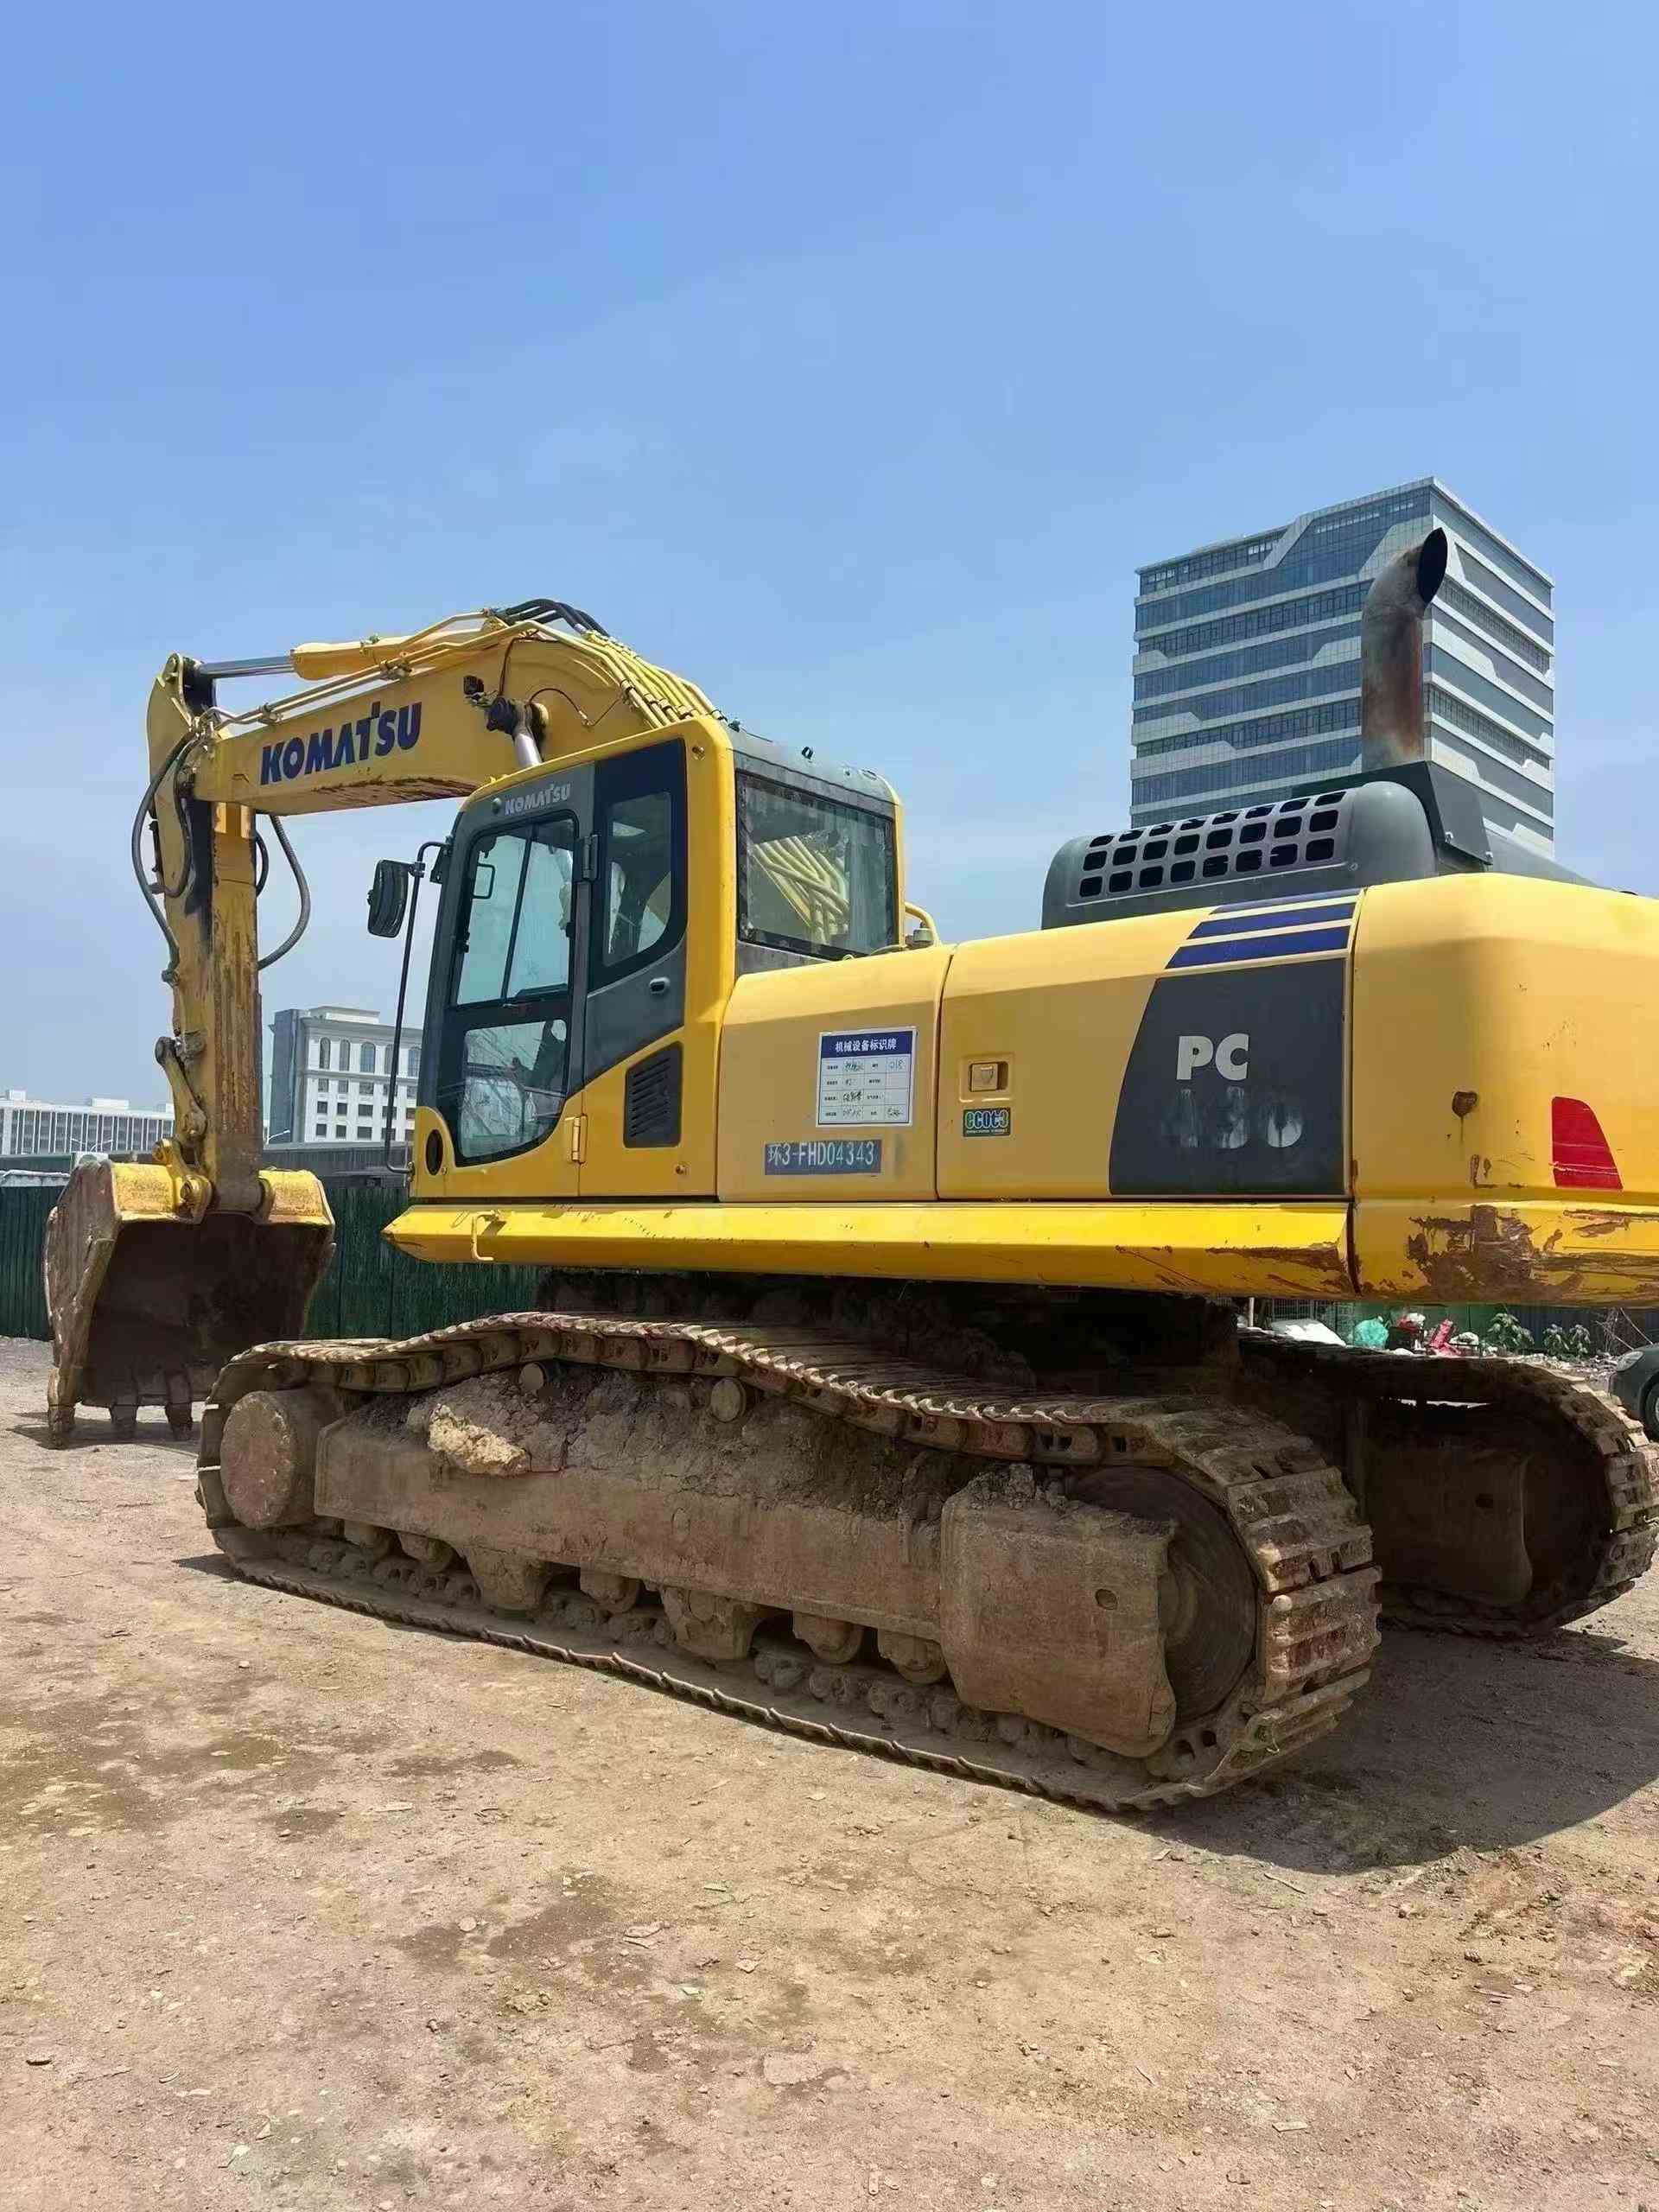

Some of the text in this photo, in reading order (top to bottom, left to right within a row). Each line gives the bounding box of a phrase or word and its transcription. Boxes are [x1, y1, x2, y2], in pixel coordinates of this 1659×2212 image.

[261, 701, 422, 785] KOMATSU
[505, 783, 571, 817] KOMATSU
[835, 1038, 897, 1052] 机械设备标识牌
[1176, 1033, 1249, 1081] PC
